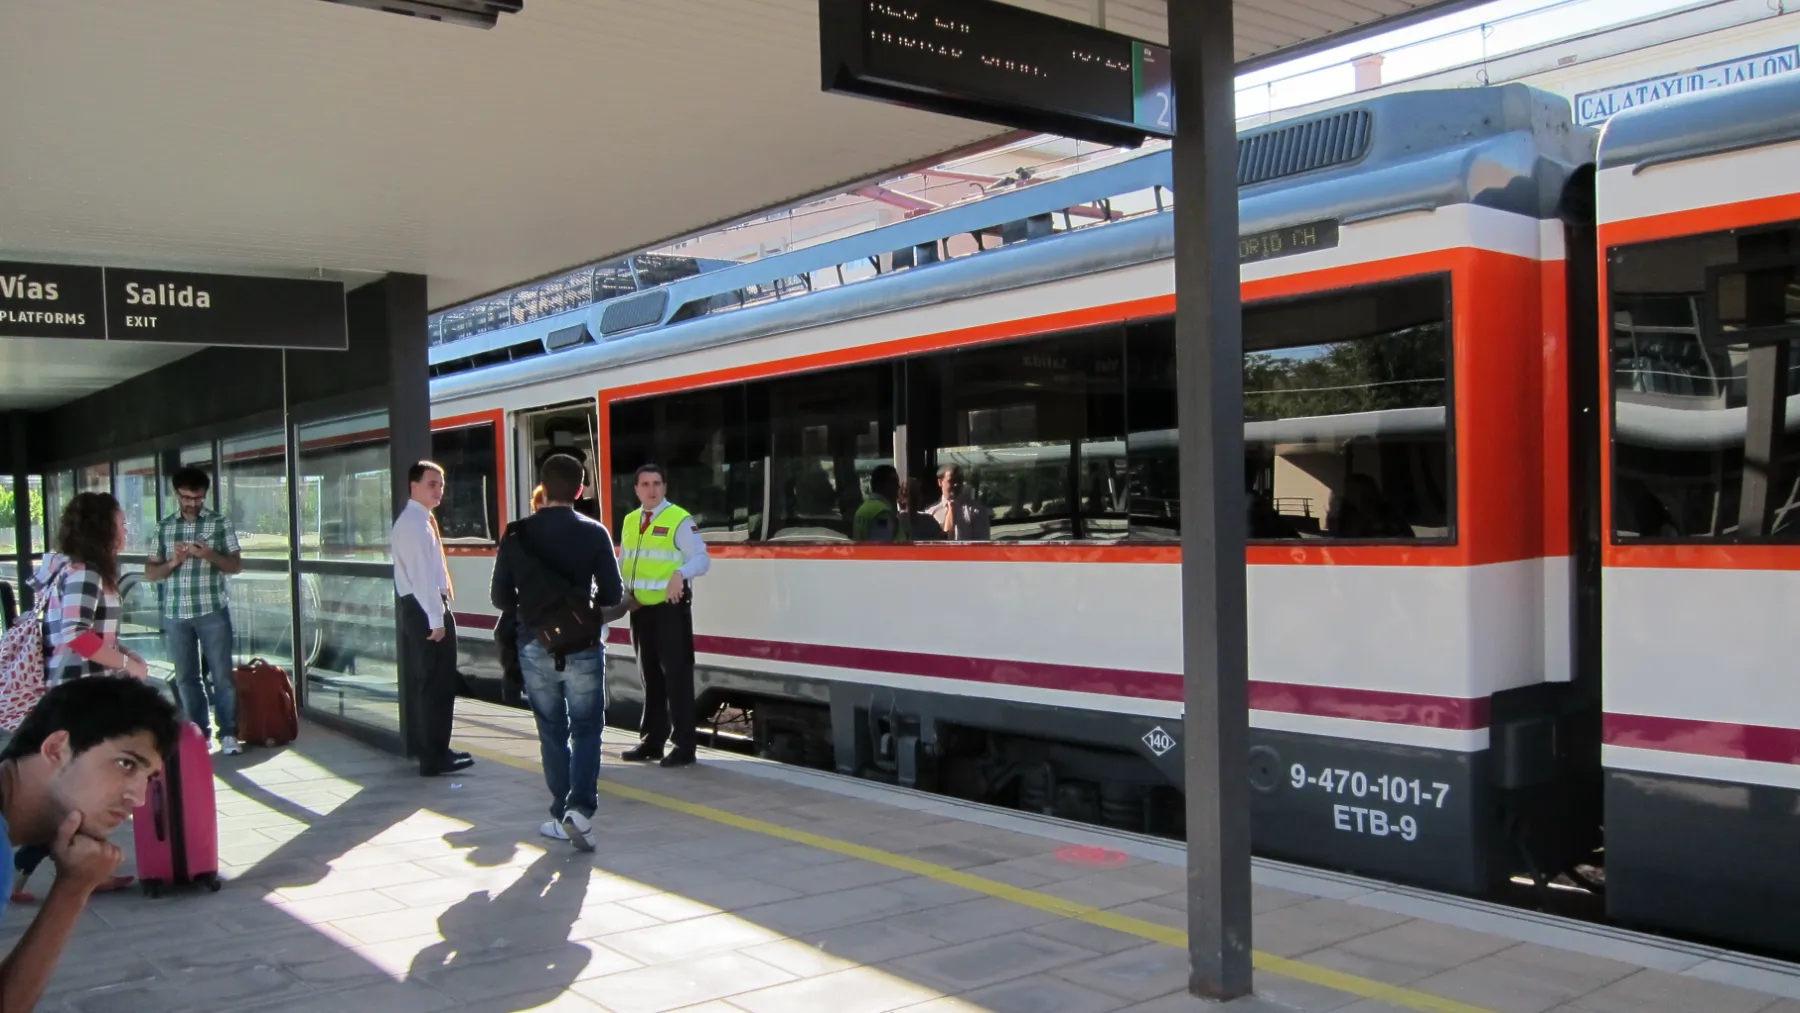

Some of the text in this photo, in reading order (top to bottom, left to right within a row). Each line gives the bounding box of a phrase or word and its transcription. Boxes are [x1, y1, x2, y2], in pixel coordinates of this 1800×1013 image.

[1157, 92, 1169, 126] 2
[0, 275, 58, 300] Vías
[126, 282, 211, 307] Salida
[0, 310, 86, 325] PLATFORMS
[126, 315, 157, 328] EXIT
[1149, 734, 1169, 749] 140
[1290, 763, 1449, 808] 9-470-101-7
[1333, 804, 1417, 841] ETB-9
